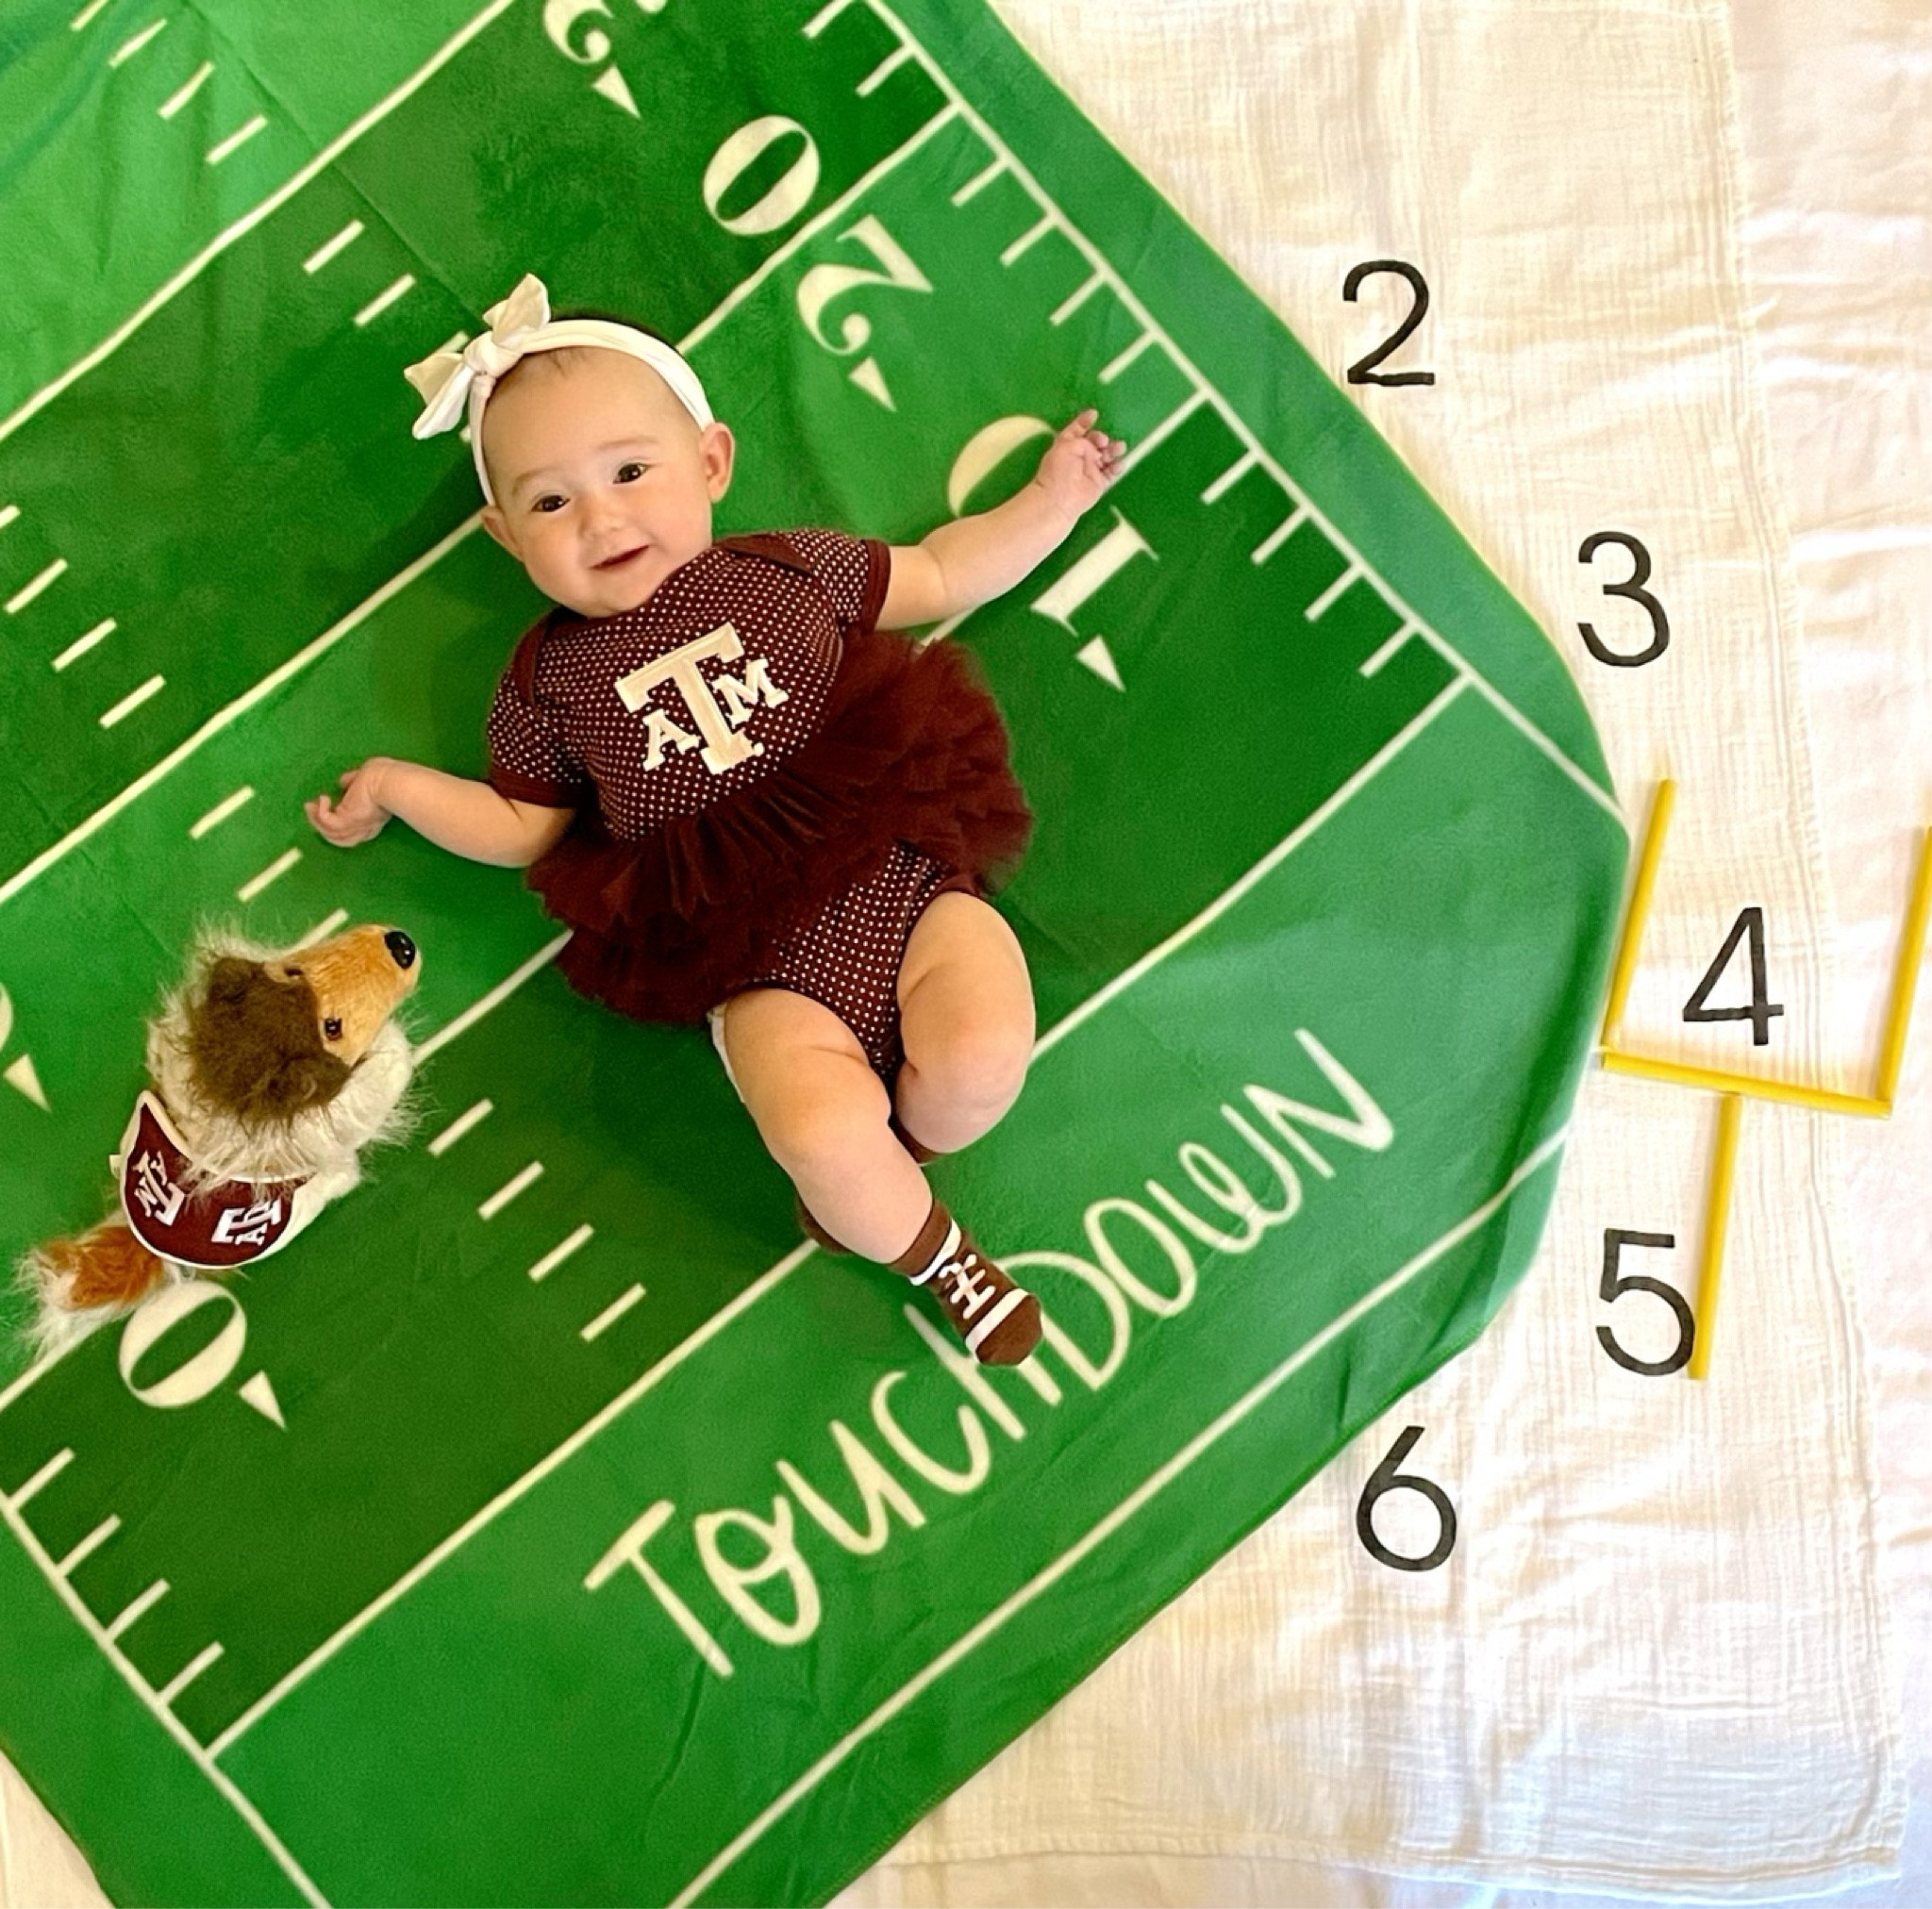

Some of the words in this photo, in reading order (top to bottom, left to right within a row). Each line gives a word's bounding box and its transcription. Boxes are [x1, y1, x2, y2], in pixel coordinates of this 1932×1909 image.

[1342, 260, 1436, 387] 2
[1577, 531, 1671, 668] 3
[1683, 906, 1784, 1047] 4
[1595, 1228, 1695, 1377] 5
[1356, 1424, 1457, 1572] 6
